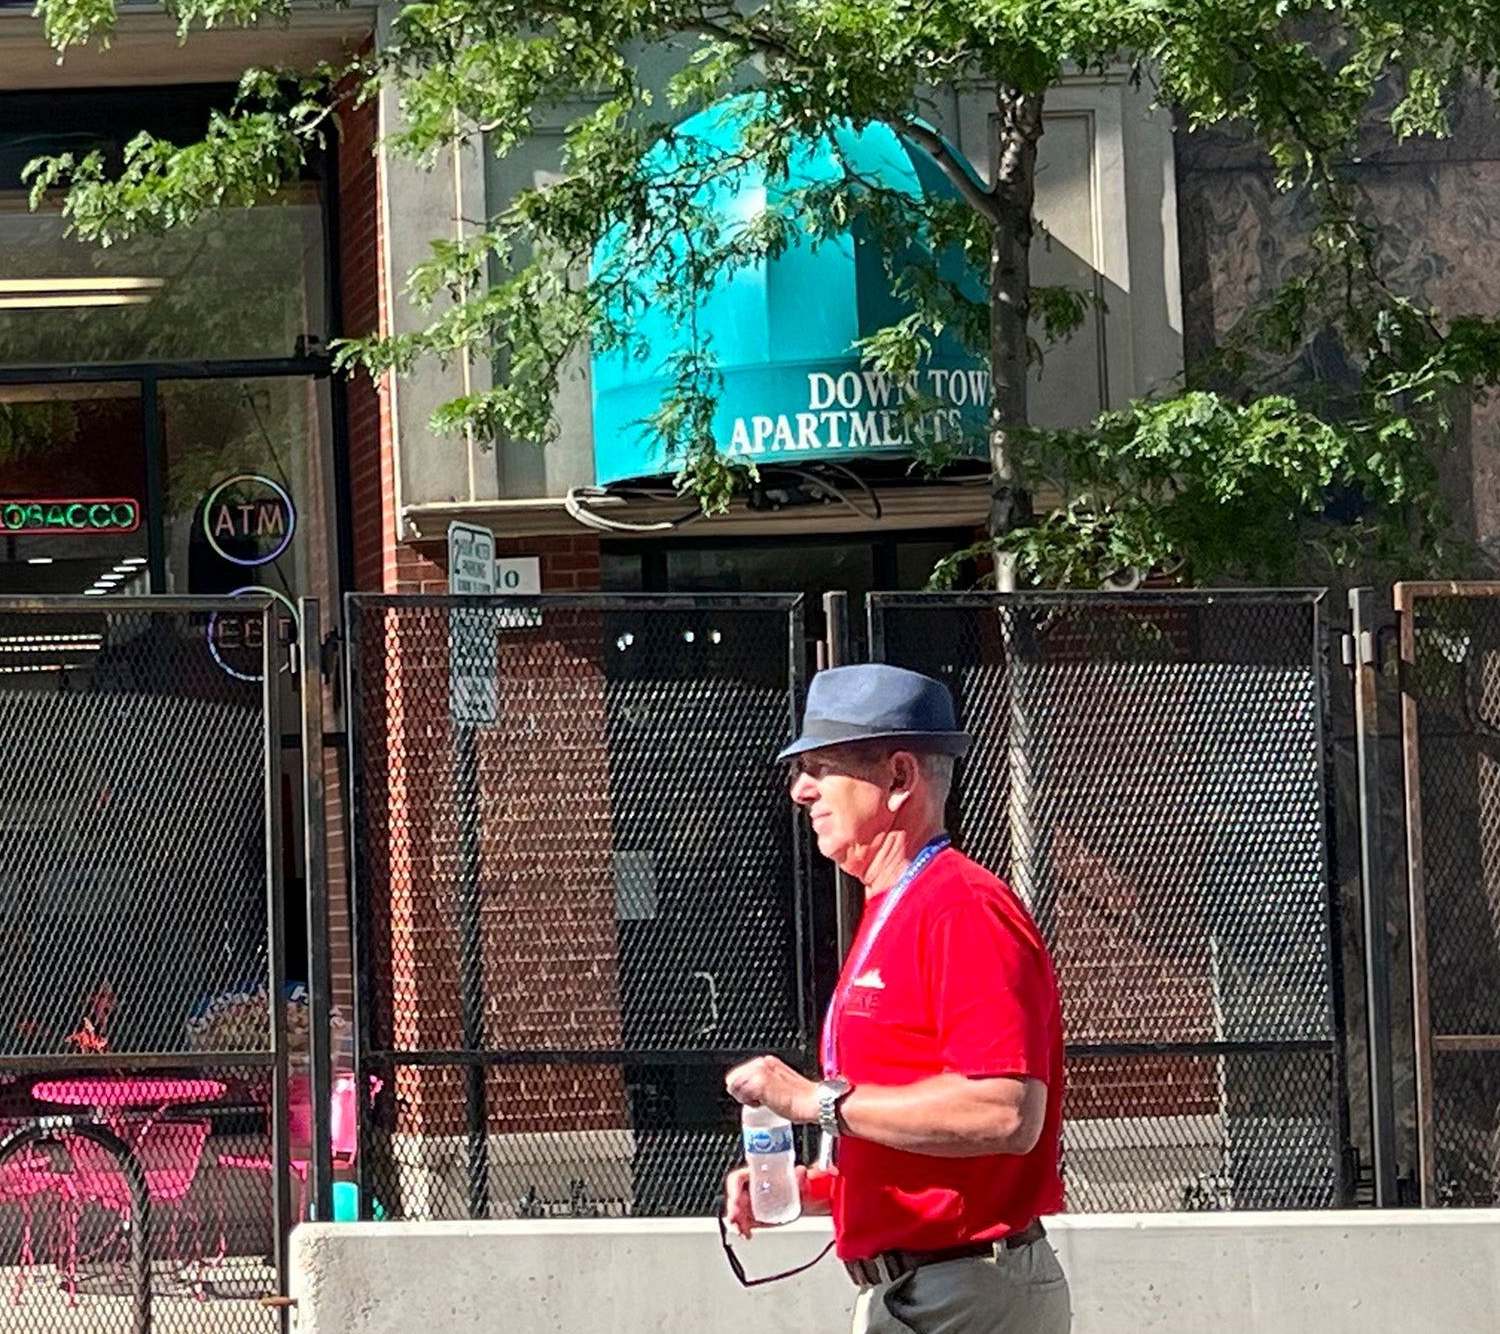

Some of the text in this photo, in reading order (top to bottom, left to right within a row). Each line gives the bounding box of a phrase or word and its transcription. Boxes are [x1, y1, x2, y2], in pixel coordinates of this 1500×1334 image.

[807, 368, 993, 411] DOWN TOW
[214, 503, 285, 537] ATM
